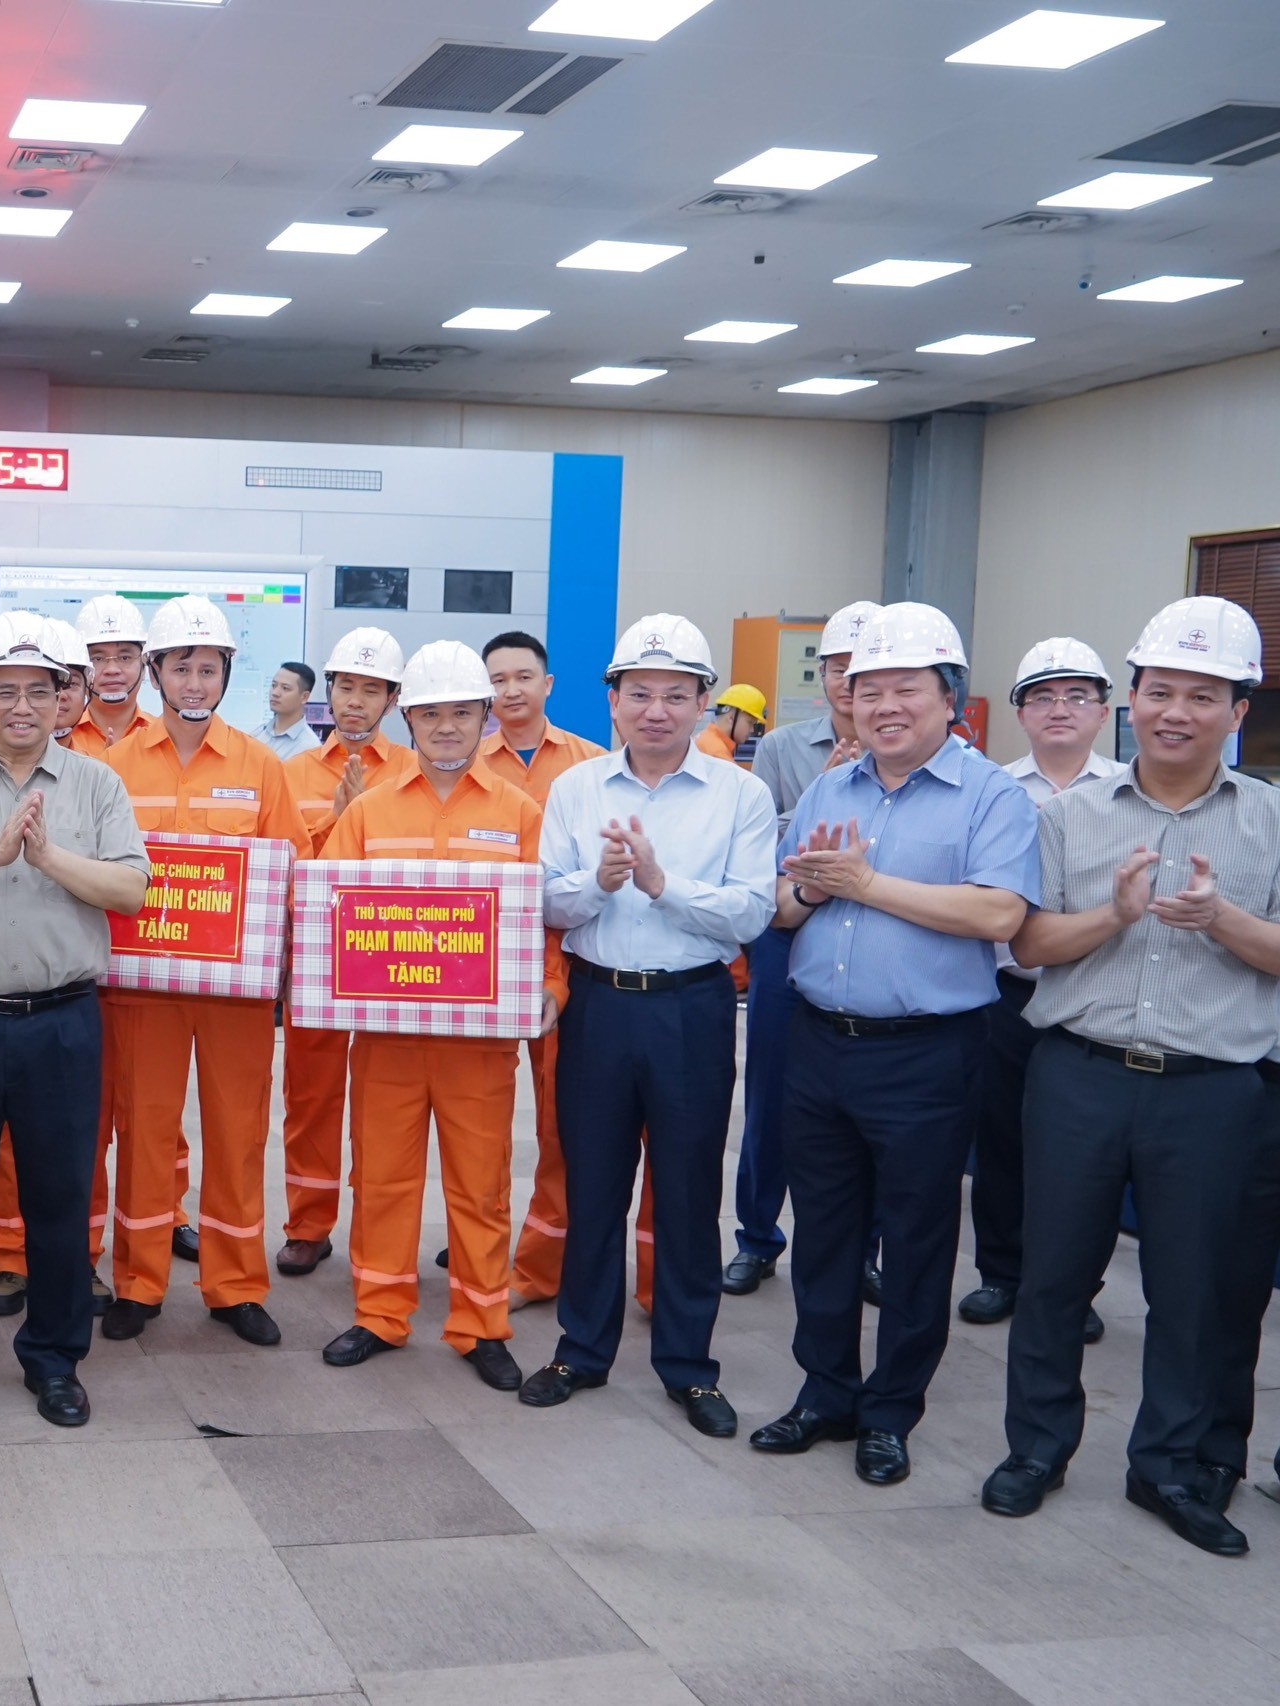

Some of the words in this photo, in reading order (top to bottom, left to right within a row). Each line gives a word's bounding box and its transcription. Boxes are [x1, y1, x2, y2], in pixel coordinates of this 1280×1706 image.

[168, 862, 200, 880] CHÍNH
[204, 862, 224, 880] PHỦ
[144, 886, 184, 910] MINH
[187, 886, 232, 913] CHÍNH
[354, 902, 375, 920] THỦ
[377, 904, 412, 920] TƯỚNG
[416, 904, 450, 921] CHÍNH
[452, 904, 475, 922] PHỦ
[137, 917, 189, 942] TẶNG!
[345, 930, 388, 956] PHẠM
[393, 931, 433, 952] MINH
[437, 927, 484, 954] CHÍNH
[387, 962, 441, 987] TẶNG!
